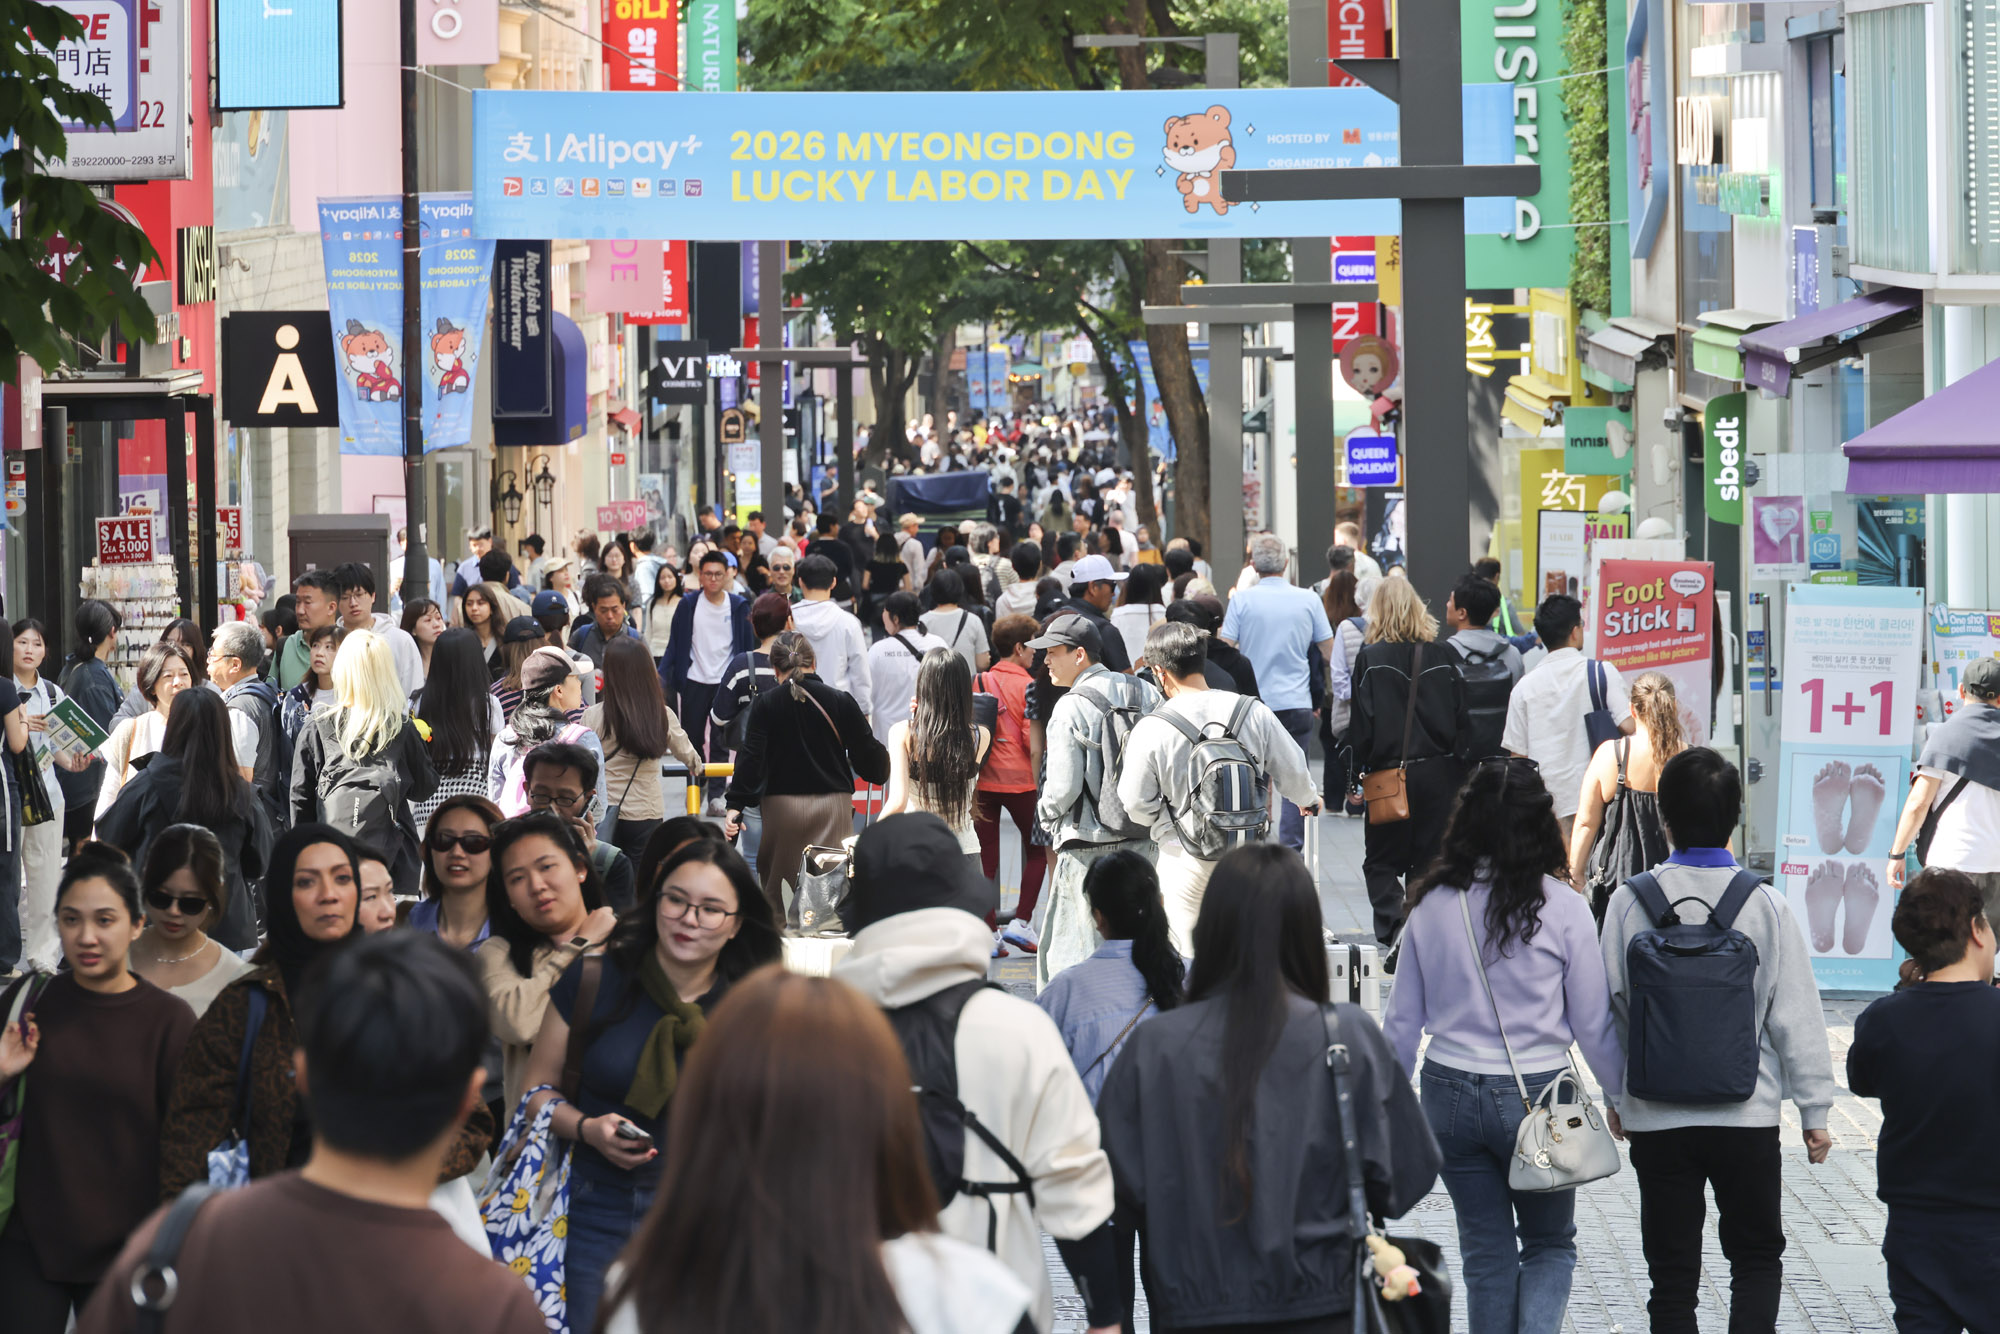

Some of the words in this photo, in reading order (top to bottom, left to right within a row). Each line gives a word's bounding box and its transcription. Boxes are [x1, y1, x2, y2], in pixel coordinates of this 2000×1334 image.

[24, 48, 112, 76] 門店
[730, 131, 826, 161] 2026
[837, 131, 1136, 161] MYEONGDONG
[1267, 134, 1312, 144] HOSTED
[1315, 134, 1330, 143] BY
[556, 133, 703, 170] Alipay+
[1267, 158, 1334, 168] ORGANIZED
[1336, 158, 1352, 167] BY
[731, 170, 875, 202] LUCKY
[887, 169, 1030, 201] LABOR
[1042, 168, 1135, 200] DAY
[184, 225, 216, 305] MISSHA
[1337, 264, 1375, 277] QUEEN
[1351, 447, 1389, 460] QUEEN
[1713, 416, 1740, 502] sbedt
[1348, 462, 1395, 475] HOLIDAY
[100, 523, 149, 541] SALE
[1606, 577, 1665, 608] Foot
[1604, 604, 1671, 637] Stick
[1950, 615, 1966, 625] One
[1967, 614, 1985, 625] shot
[1749, 635, 1764, 644] VIS
[1800, 679, 1894, 736] 1+1
[1785, 837, 1807, 845] Before
[1783, 865, 1807, 875] After
